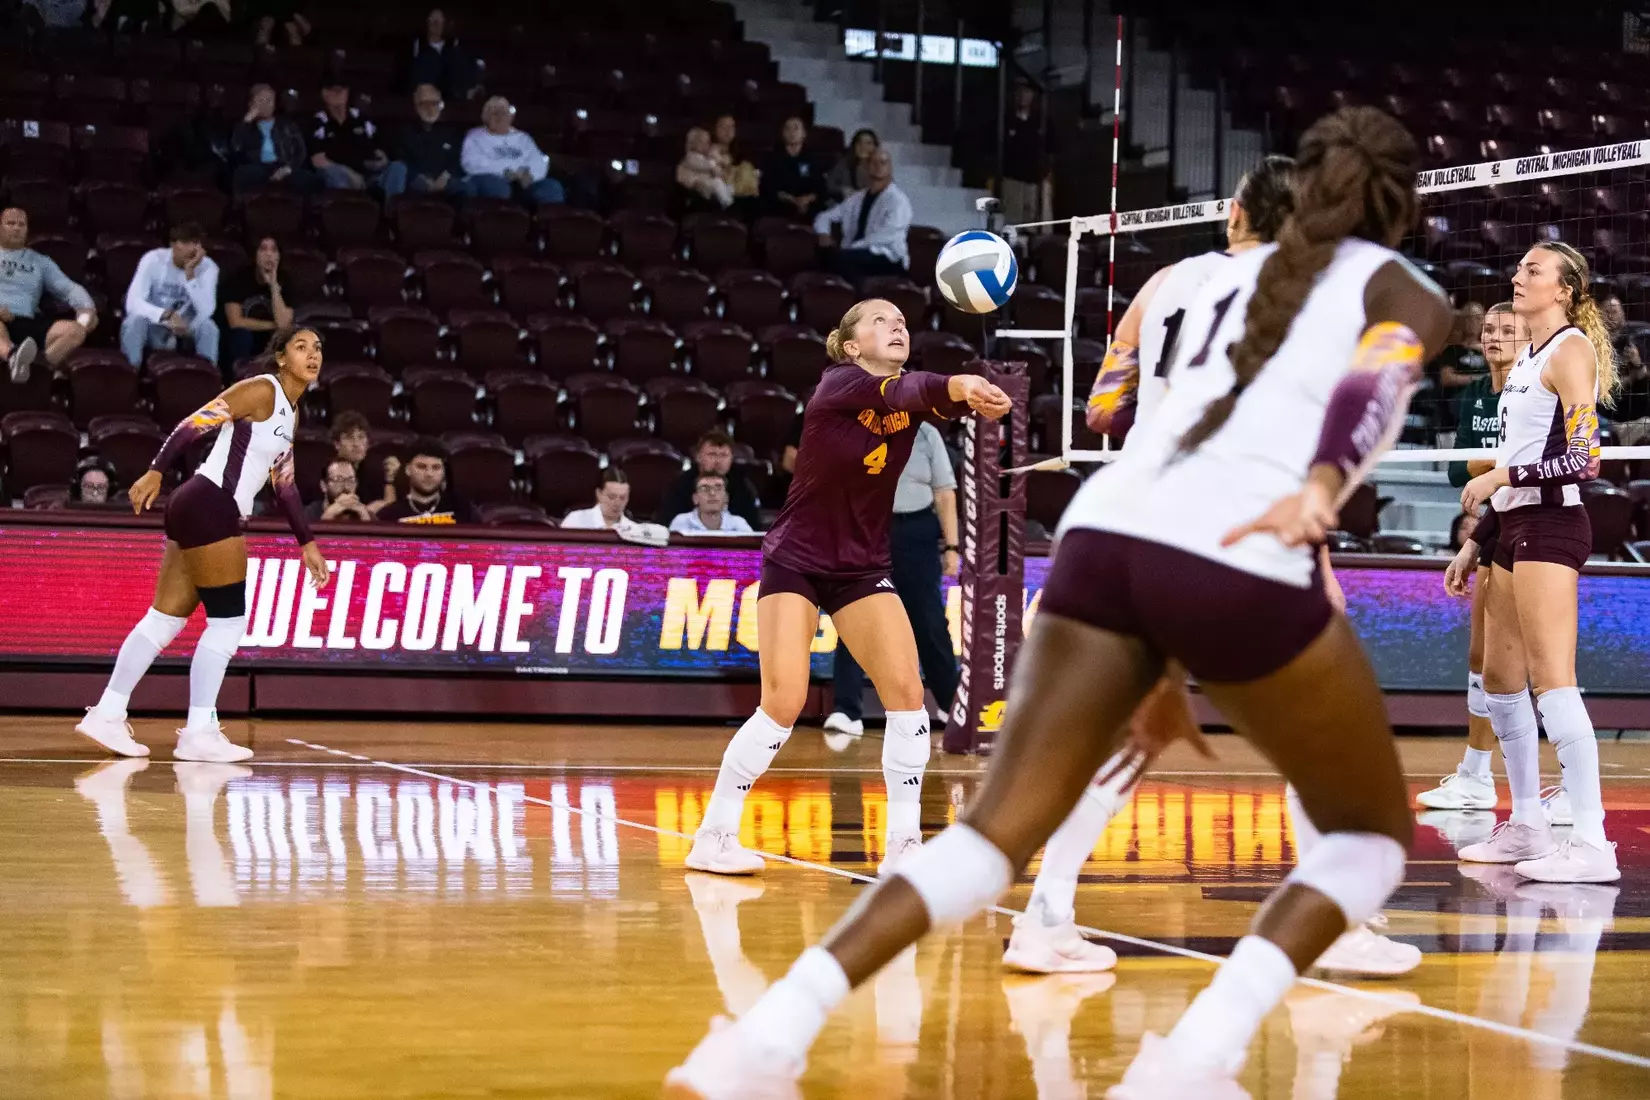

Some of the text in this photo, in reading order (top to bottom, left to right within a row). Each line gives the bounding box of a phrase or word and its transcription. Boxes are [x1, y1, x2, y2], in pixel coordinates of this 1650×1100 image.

[1516, 142, 1641, 175] CENTRAL MICHIGAN VOLLEYBALL
[1434, 166, 1476, 186] VOLLEYBALL
[1121, 203, 1205, 226] CENTRAL MICHIGAN VOLLEYBALL
[1472, 415, 1500, 432] EASTE
[863, 442, 888, 474] 4
[238, 557, 541, 653] WELCOME
[555, 566, 629, 655] TO
[953, 583, 975, 727] CENTRAL
[993, 594, 1007, 690] sports imports
